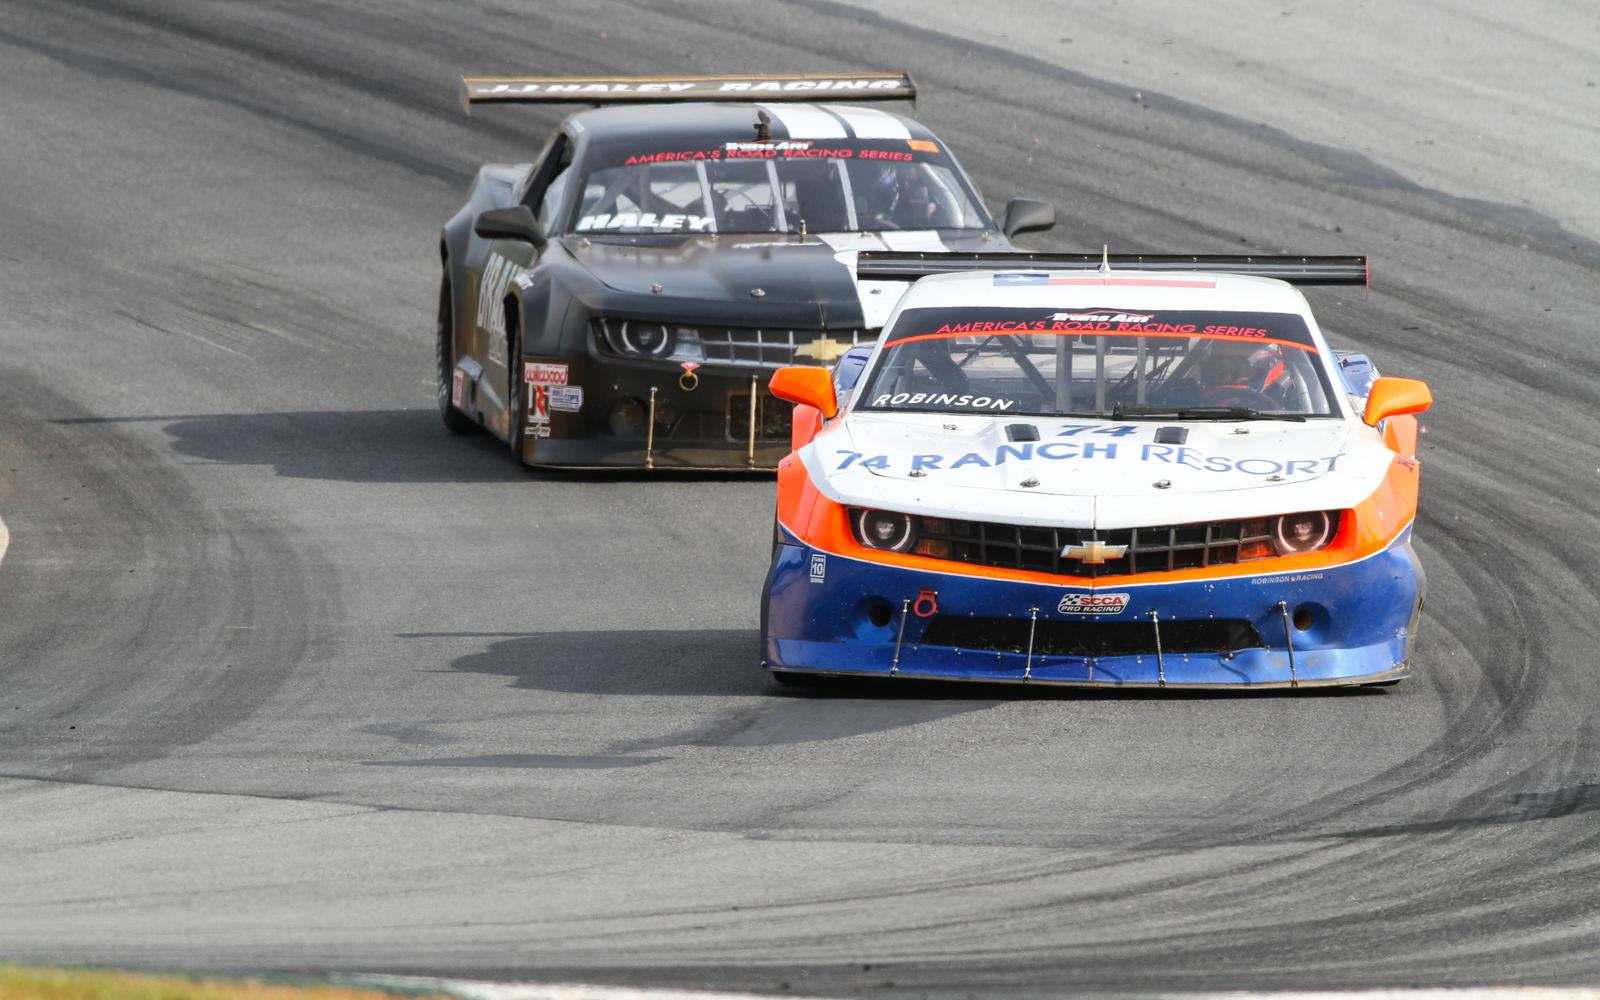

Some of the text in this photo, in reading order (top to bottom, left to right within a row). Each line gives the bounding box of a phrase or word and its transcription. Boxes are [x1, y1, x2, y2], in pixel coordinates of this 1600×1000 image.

[546, 83, 697, 93] HALEY
[720, 80, 900, 92] RACING
[726, 142, 808, 151] Trans Am
[624, 149, 913, 166] AMERICA'S ROAD RACING SERIES
[575, 212, 715, 231] HALEY
[1052, 312, 1150, 323] Trans Am
[936, 320, 1268, 338] AMERICA'S ROAD RACING SERIES
[872, 392, 1014, 410] ROBINSON
[1056, 424, 1139, 437] 74
[836, 442, 1346, 475] 74 RANCH RESORT
[812, 562, 823, 575] 10
[1251, 573, 1324, 585] ROBINSON RACING
[1079, 596, 1123, 606] SCCA
[1083, 605, 1122, 613] RACING
